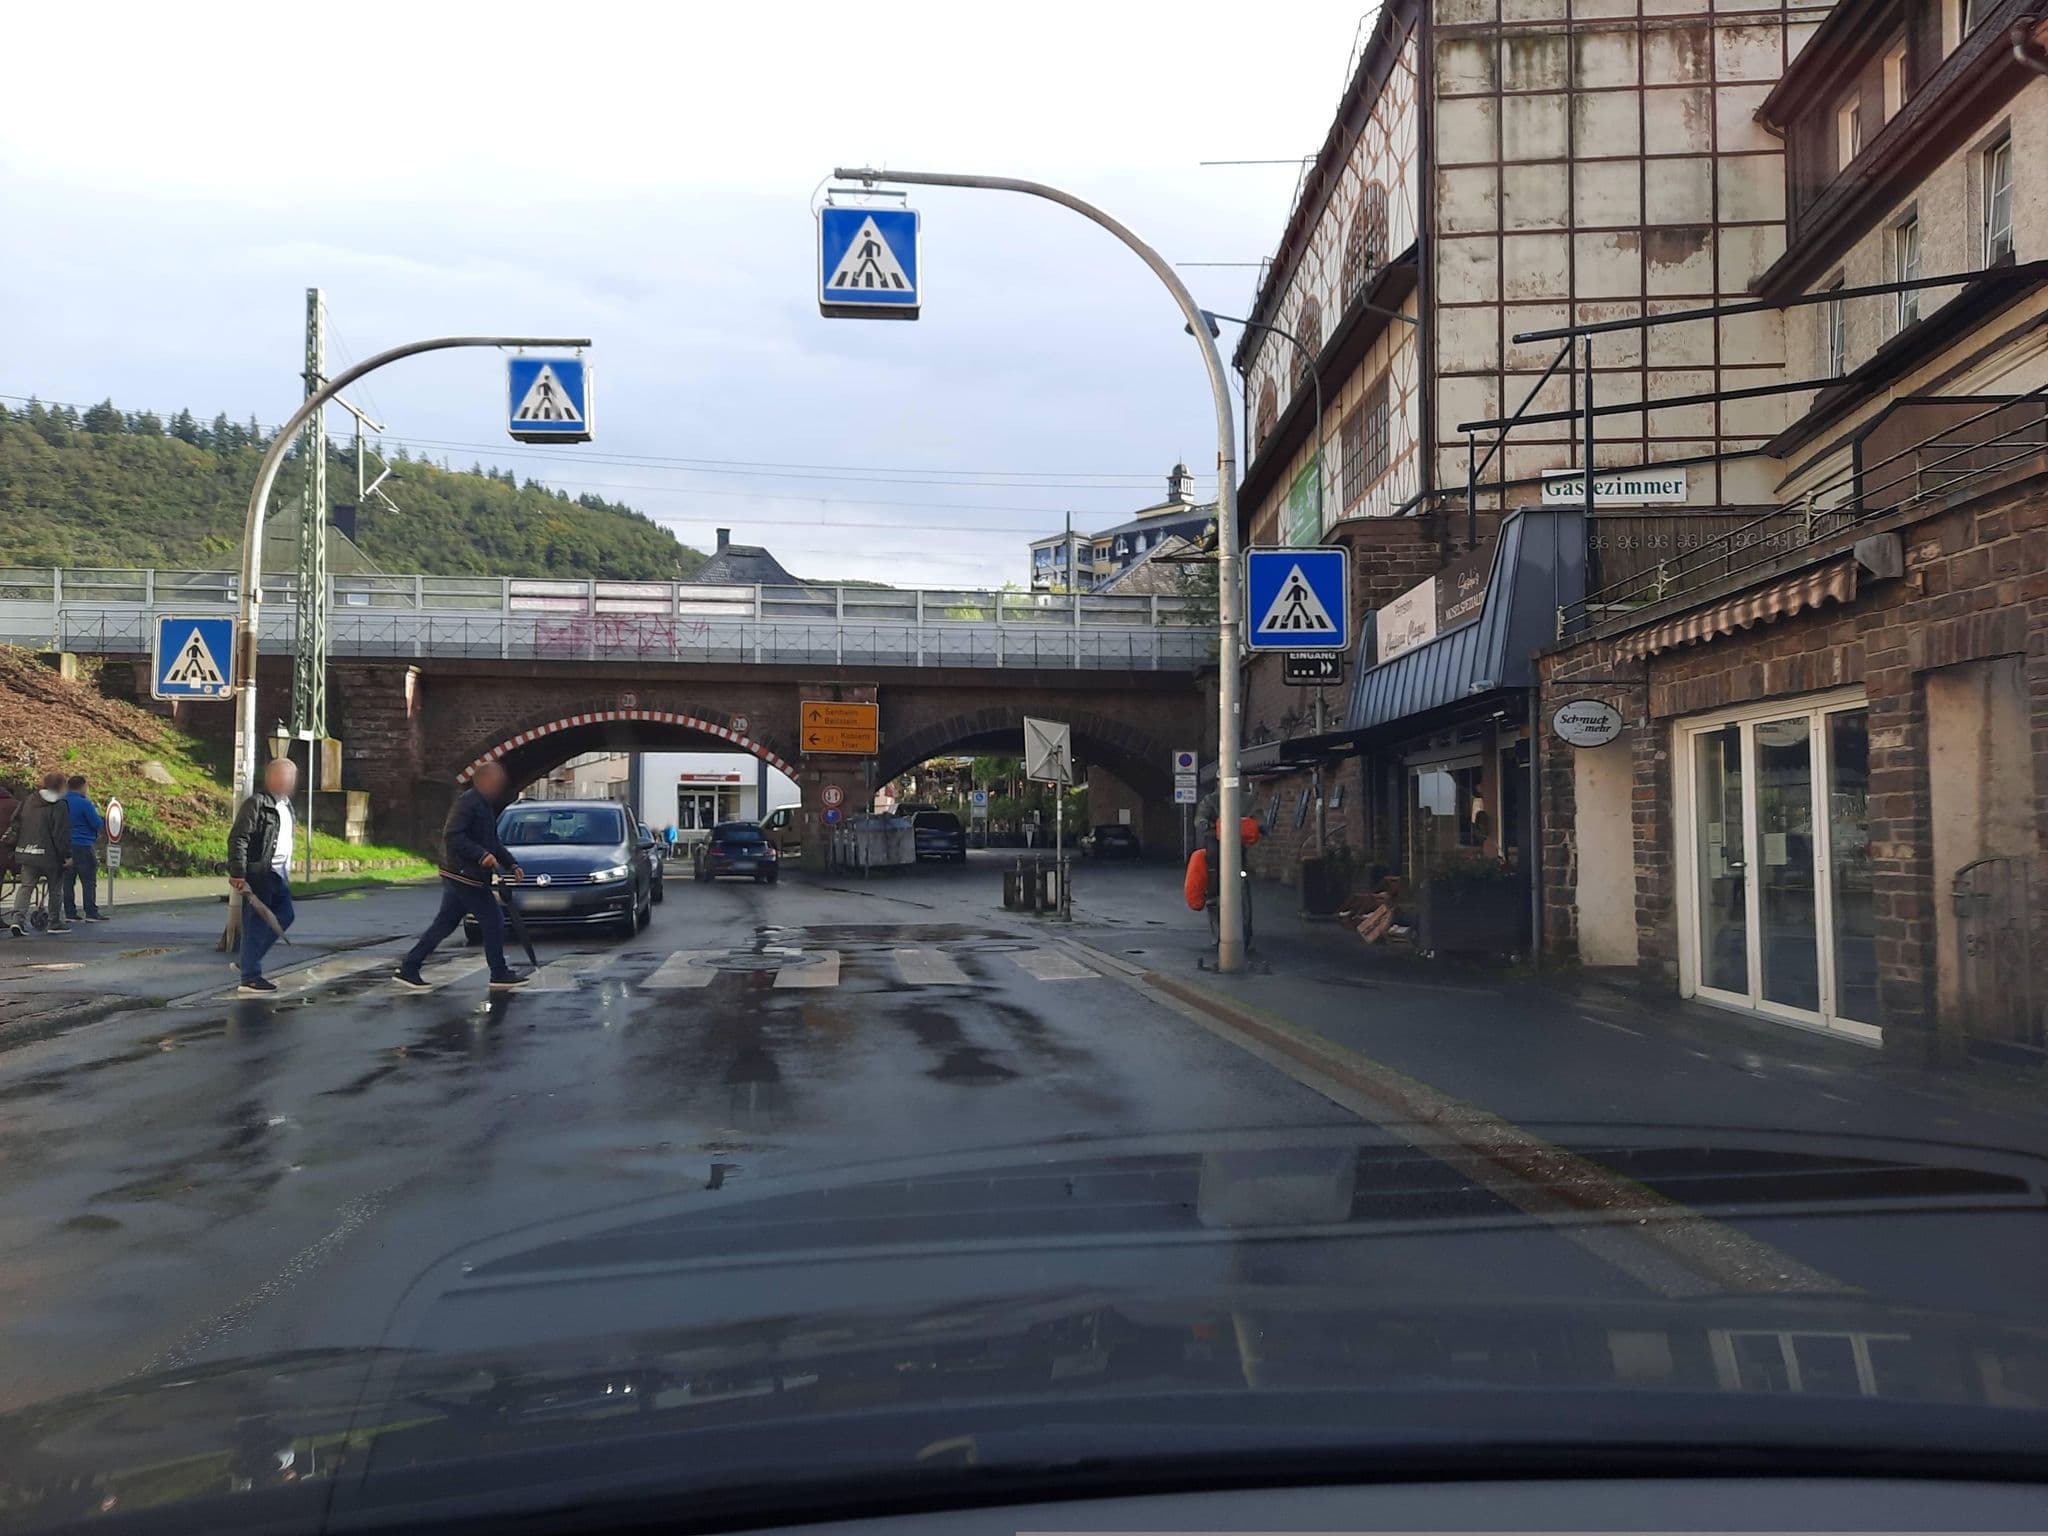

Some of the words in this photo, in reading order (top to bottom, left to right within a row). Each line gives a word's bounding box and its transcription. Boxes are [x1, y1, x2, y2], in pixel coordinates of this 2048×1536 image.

[1290, 652, 1336, 660] EINGANG
[1560, 714, 1609, 725] Schmuck
[1584, 723, 1612, 733] mehr
[841, 741, 859, 749] Trier
